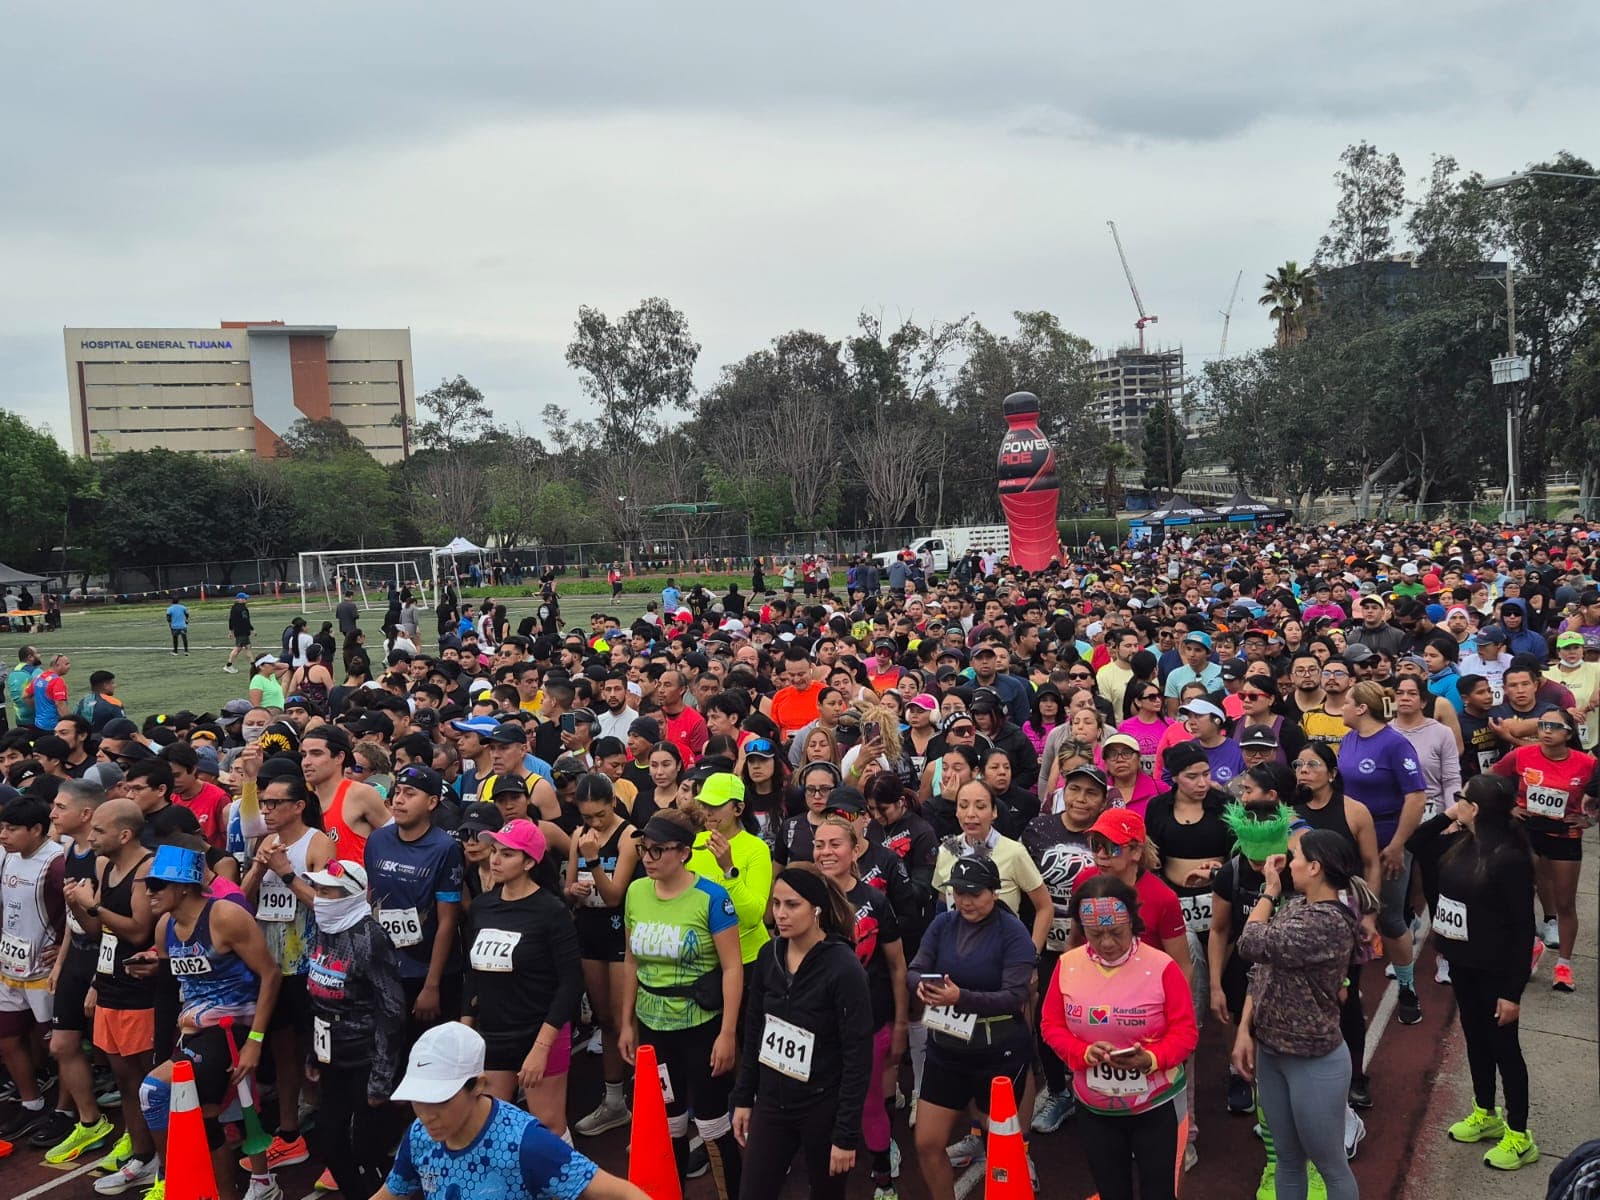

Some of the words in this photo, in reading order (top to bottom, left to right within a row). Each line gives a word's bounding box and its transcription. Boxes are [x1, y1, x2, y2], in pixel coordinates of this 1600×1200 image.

[81, 340, 133, 349] HOSPITAL
[136, 340, 185, 349] GENERAL
[188, 340, 233, 349] TIJUANA
[1002, 439, 1050, 454] POWER
[1528, 792, 1564, 808] 4600
[383, 860, 399, 872] 5K
[261, 893, 293, 908] 1901
[382, 919, 418, 934] 2616
[635, 921, 681, 938] RUN
[1, 940, 26, 960] 1970
[476, 940, 512, 957] 1772
[630, 935, 680, 958] RUN
[172, 957, 208, 974] 3062
[1113, 1006, 1147, 1015] Kardias
[1116, 1018, 1146, 1026] TUDN
[766, 1031, 807, 1062] 4181
